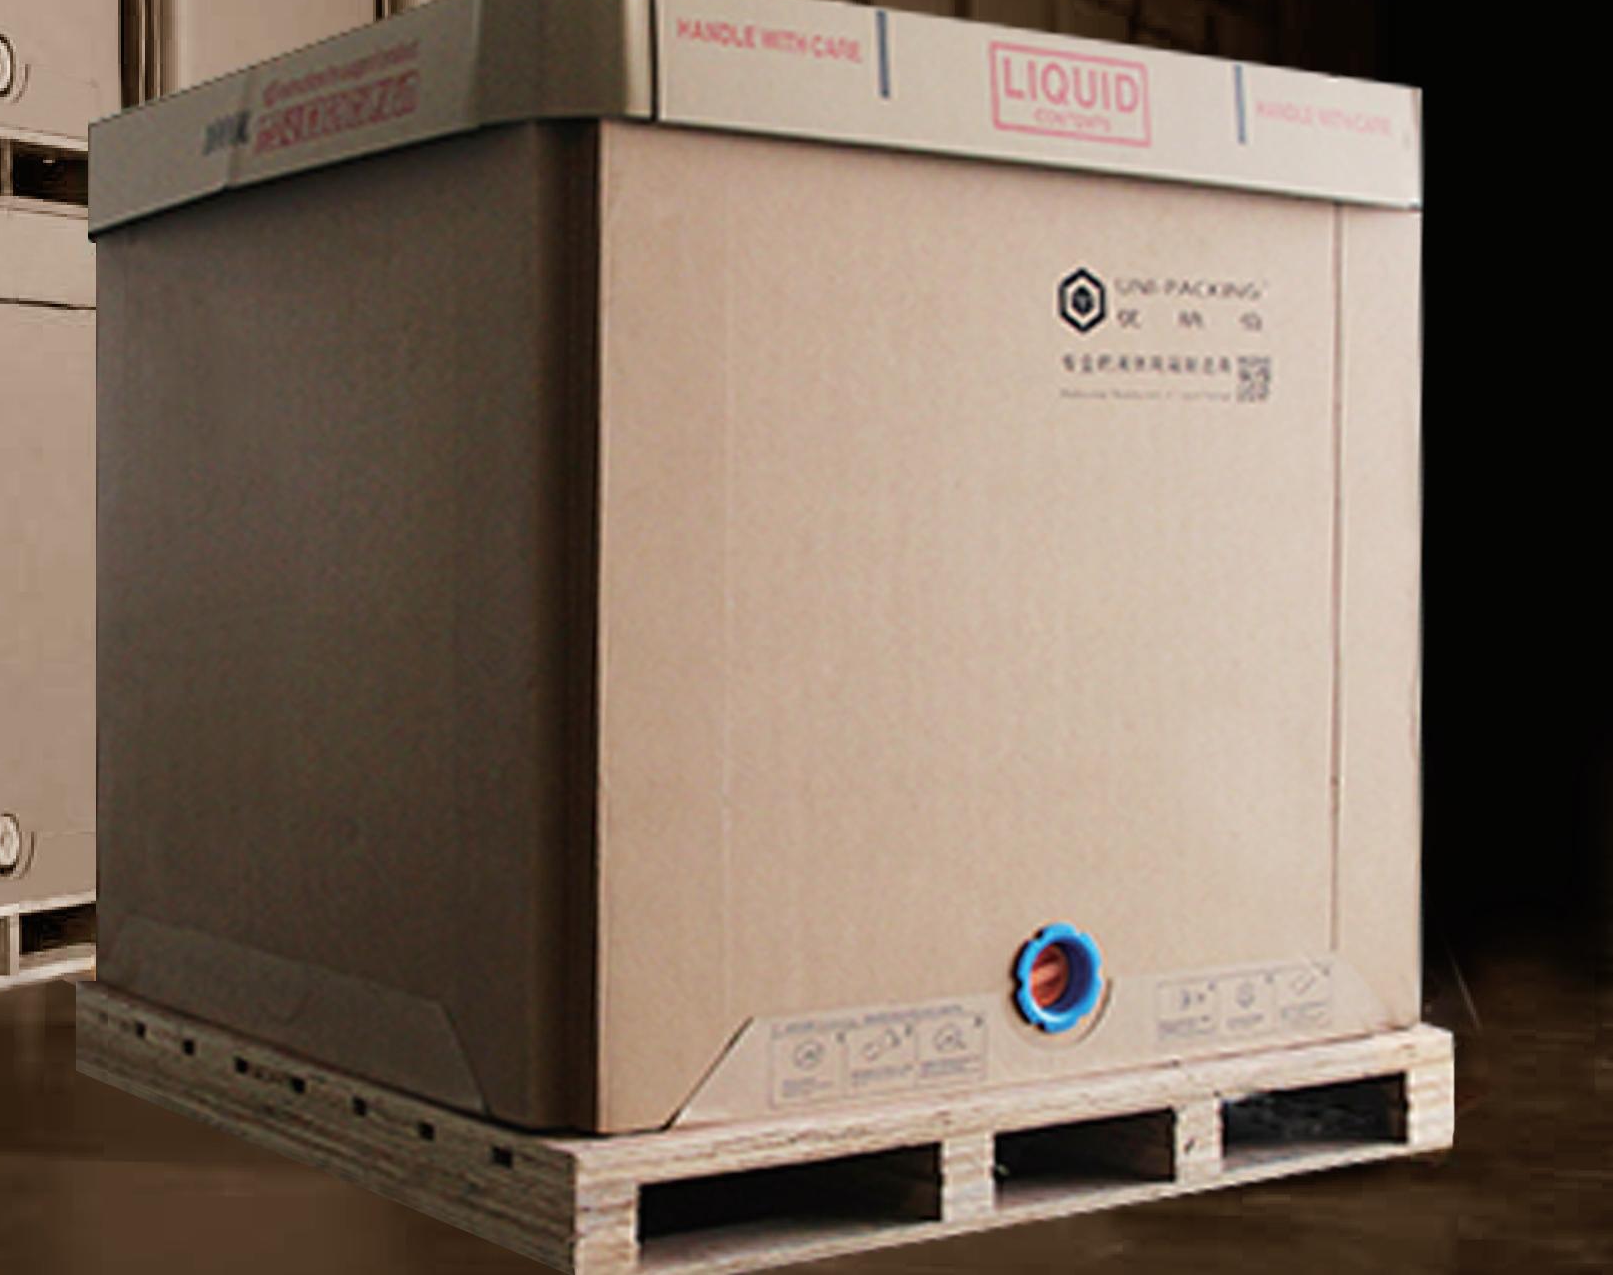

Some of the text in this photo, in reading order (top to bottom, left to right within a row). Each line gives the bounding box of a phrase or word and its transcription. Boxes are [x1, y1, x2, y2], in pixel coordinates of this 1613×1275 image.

[676, 17, 863, 64] HANDLE WITH CARE
[1002, 56, 1140, 114] LIQUID
